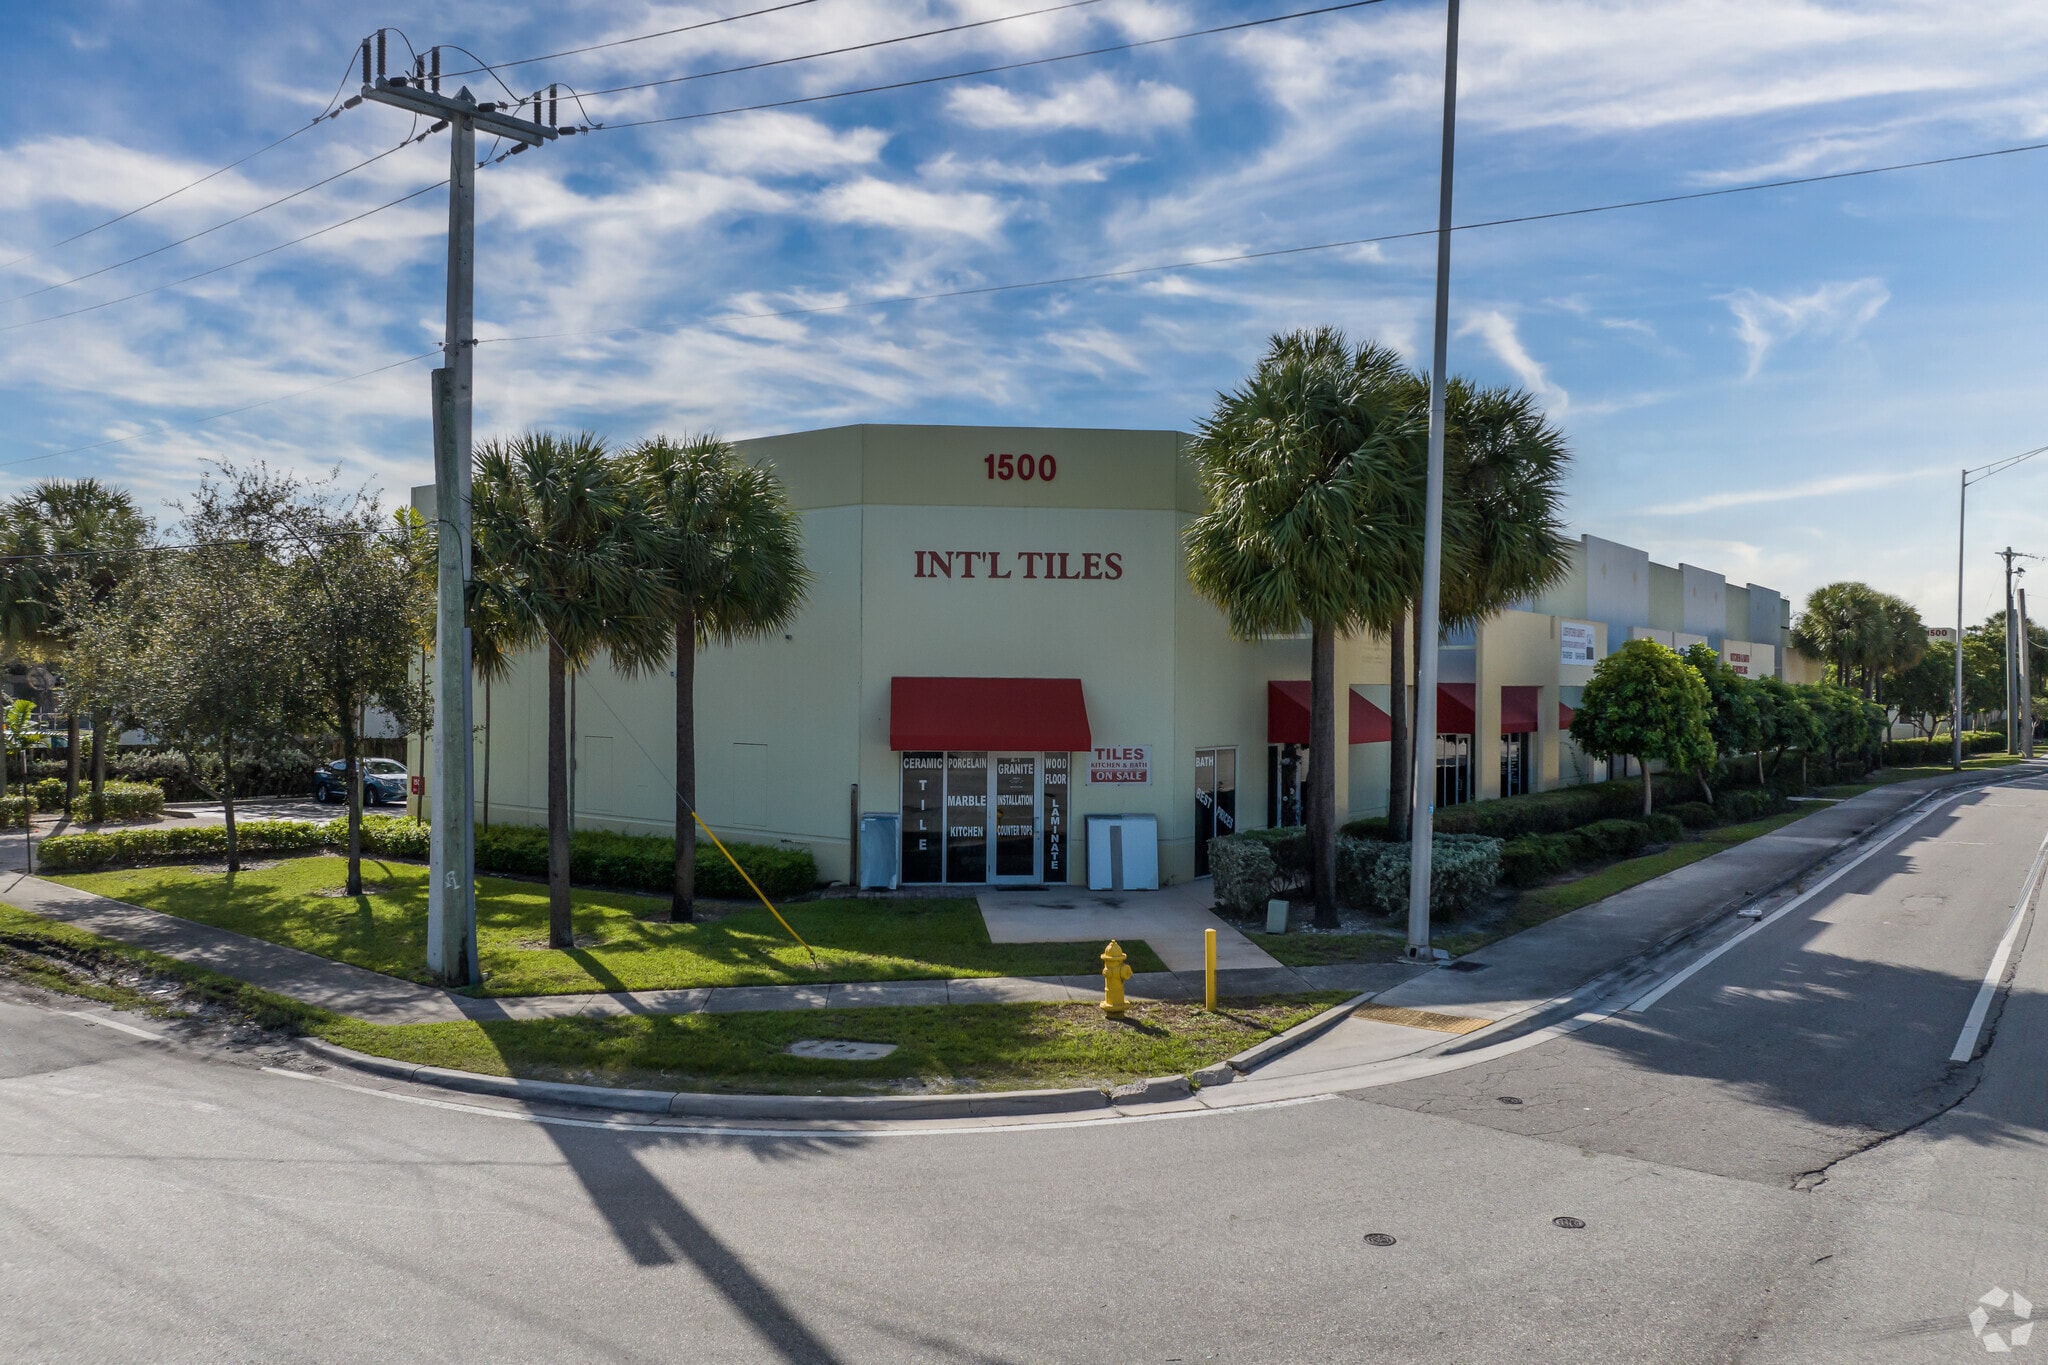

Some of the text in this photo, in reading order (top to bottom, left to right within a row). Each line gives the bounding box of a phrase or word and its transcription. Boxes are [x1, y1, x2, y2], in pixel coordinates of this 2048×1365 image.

[984, 454, 1057, 481] 1500
[914, 551, 1123, 580] INT'L TILES
[1094, 748, 1144, 760] TILES
[903, 758, 943, 769] CERAMIC
[948, 758, 987, 769] PORCELAIN
[1045, 758, 1067, 769] WOOD
[1195, 756, 1214, 768] BATH
[998, 763, 1034, 774] GRANITE
[1045, 773, 1067, 784] FLOOR
[1096, 771, 1142, 780] ON SALE
[947, 795, 987, 807] MARBLE
[997, 794, 1034, 805] INSTALLATION
[1195, 787, 1234, 829] BEST PRICES
[950, 826, 984, 837] KITCHEN
[997, 825, 1033, 836] COUNTER TOPS
[1050, 799, 1060, 870] LAMINATE
